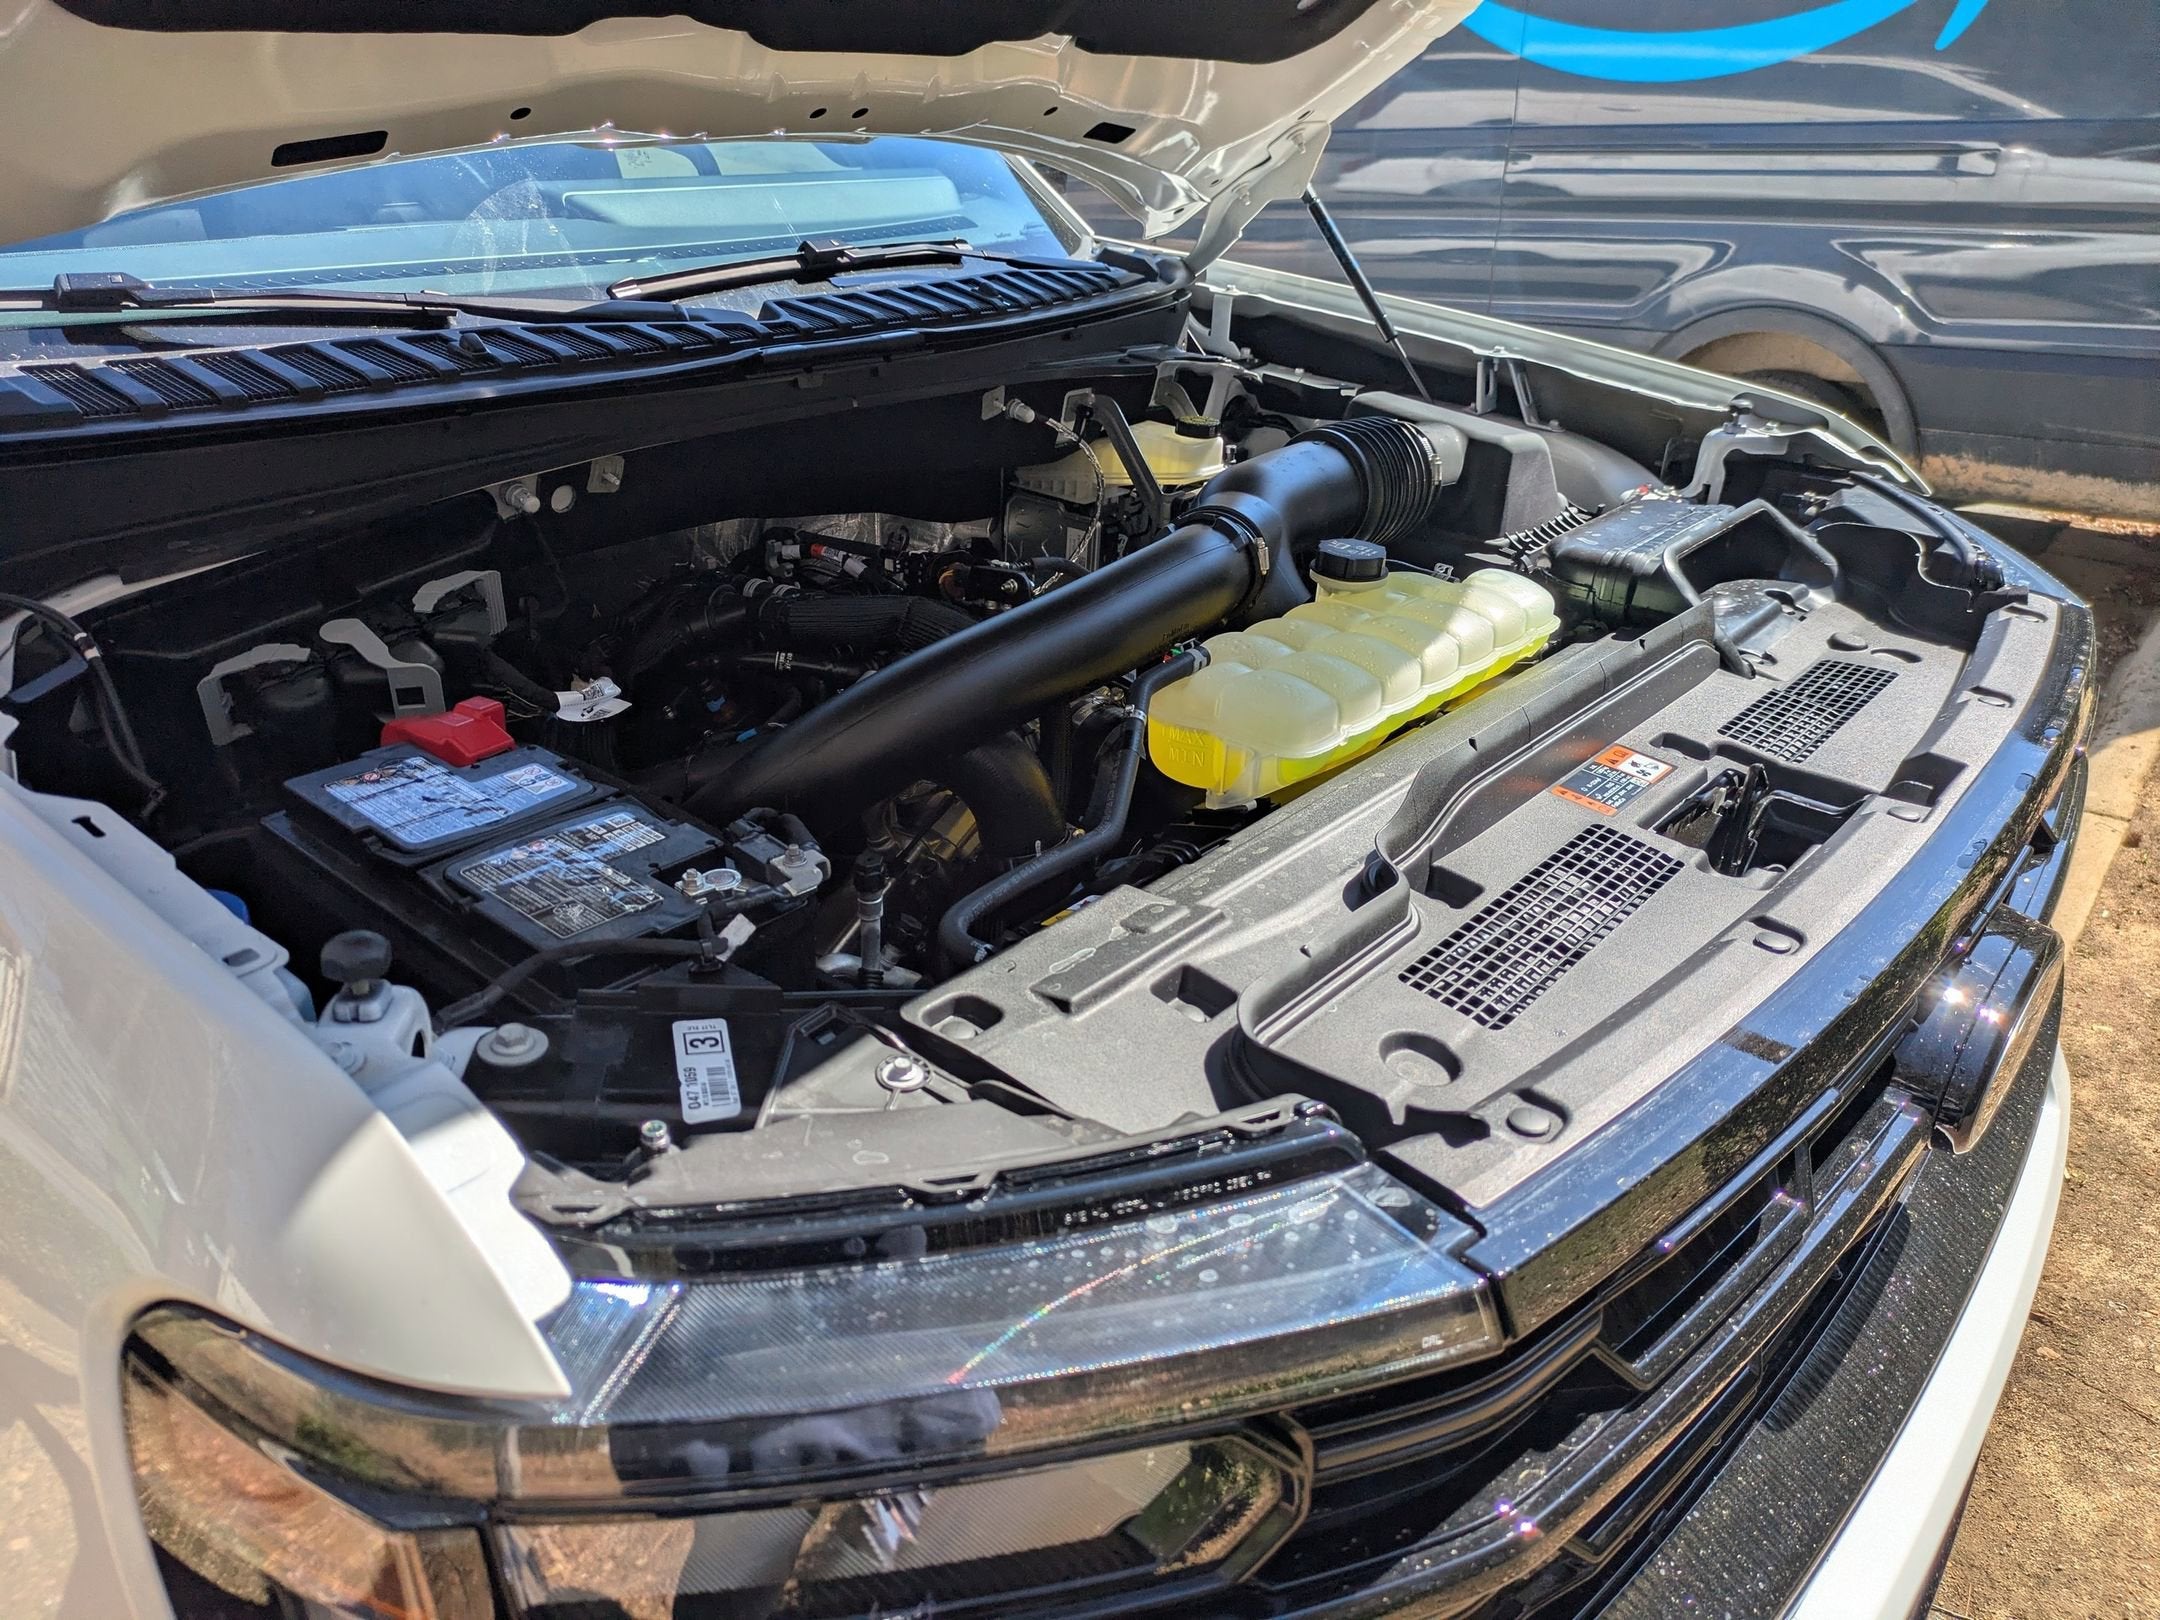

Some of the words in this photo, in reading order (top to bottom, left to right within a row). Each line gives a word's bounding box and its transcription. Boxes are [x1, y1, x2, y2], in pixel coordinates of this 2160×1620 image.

[1168, 727, 1206, 746] MAX
[1168, 747, 1204, 767] MIN
[689, 1036, 719, 1048] 3
[683, 1067, 698, 1087] 1059
[686, 1090, 701, 1110] 047
